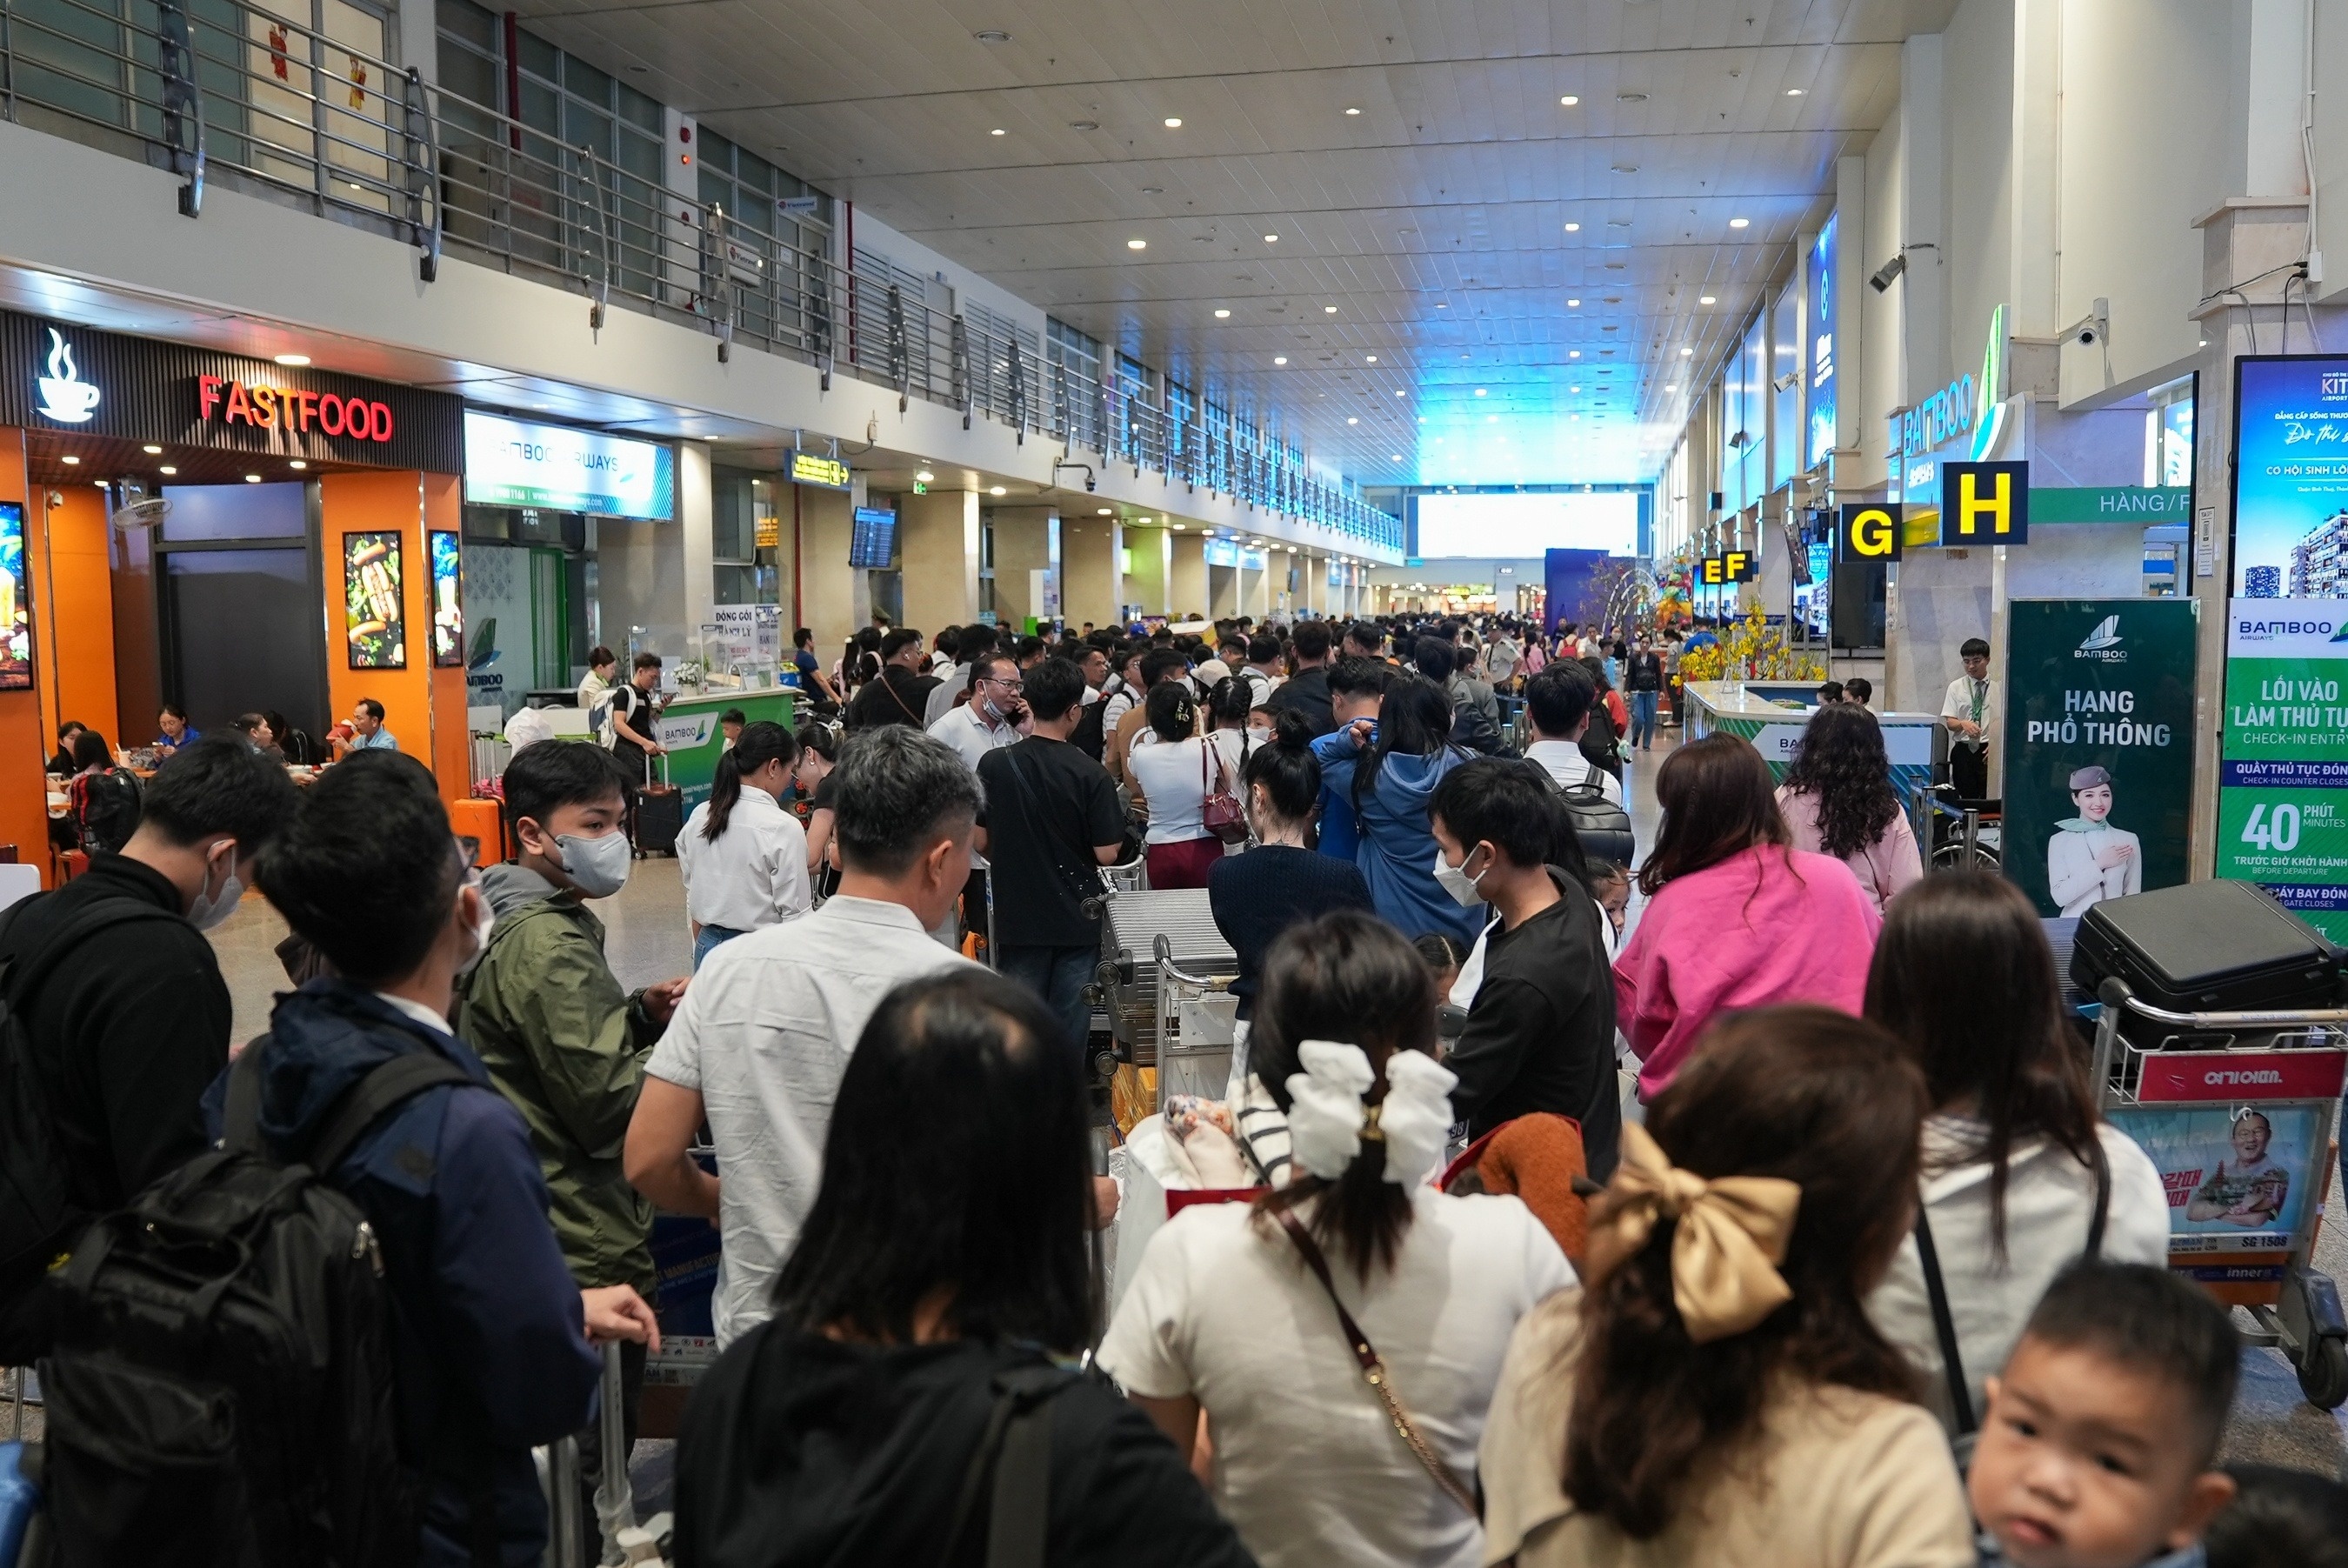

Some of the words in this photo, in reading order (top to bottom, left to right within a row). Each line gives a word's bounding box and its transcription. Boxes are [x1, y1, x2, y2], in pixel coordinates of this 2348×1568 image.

[199, 375, 393, 442] FASTFOOD
[1904, 373, 1972, 458] BAMBOO
[2284, 464, 2303, 477] HỘI
[2305, 466, 2330, 475] SINH
[1960, 473, 2011, 534] H
[1851, 510, 1892, 556] G
[1705, 560, 1721, 583] E
[1727, 554, 1745, 579] F
[2239, 621, 2332, 634] BAMBOO
[2074, 650, 2127, 659] BAMBOO
[2261, 675, 2293, 701] LỐI
[2298, 677, 2338, 702] VÀO
[2065, 690, 2134, 718] HẠNG
[2234, 702, 2275, 727] LÀM
[2280, 703, 2320, 728] THỦ
[665, 727, 696, 739] BAMBOO
[2028, 712, 2078, 744] PHỔ
[2084, 717, 2171, 746] THÔNG
[2243, 732, 2306, 744] CHECK-IN
[2236, 760, 2270, 774] QUẦY
[2271, 762, 2294, 775] THỦ
[2297, 764, 2320, 777] TỤC
[2241, 804, 2300, 851] 40
[2304, 802, 2335, 817] PHÚT
[2303, 818, 2346, 828] MINUTES
[2234, 855, 2269, 865] TRƯỚC
[2271, 856, 2290, 865] GIỜ
[2291, 855, 2317, 866] KHỞI
[2318, 856, 2348, 867] HÀNH
[2276, 885, 2295, 897] ÁY
[2297, 888, 2319, 898] BAY
[2242, 1237, 2258, 1247] SG
